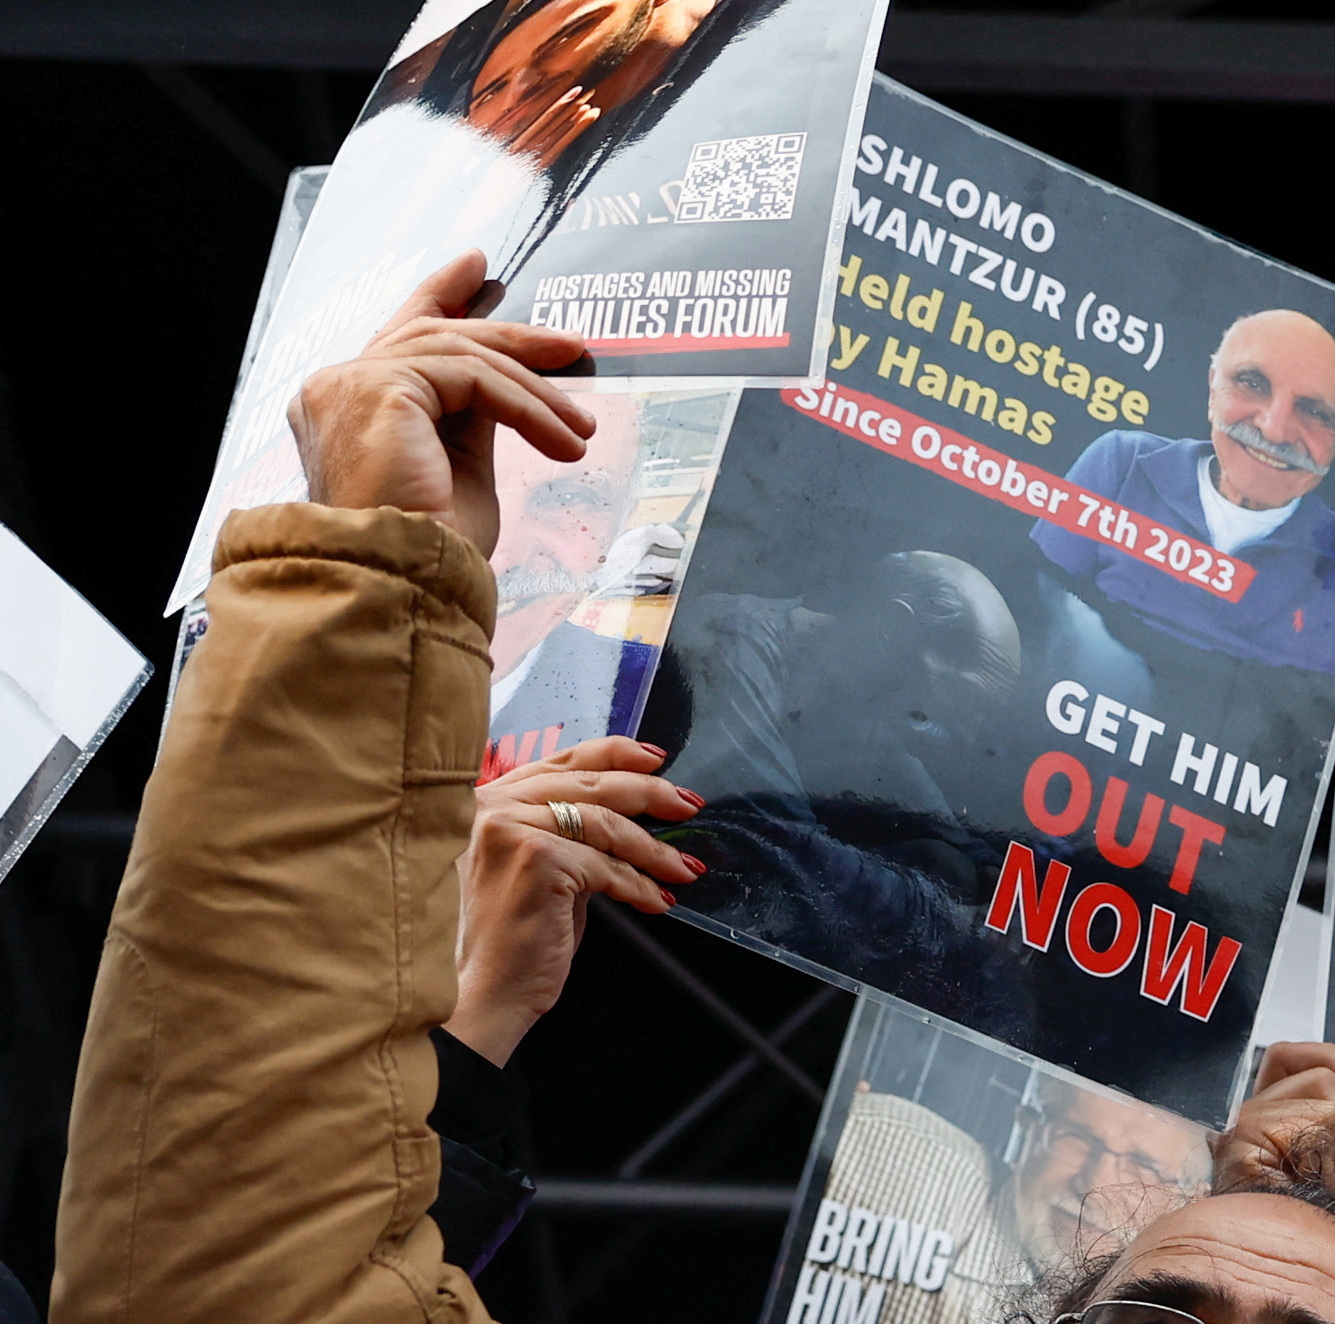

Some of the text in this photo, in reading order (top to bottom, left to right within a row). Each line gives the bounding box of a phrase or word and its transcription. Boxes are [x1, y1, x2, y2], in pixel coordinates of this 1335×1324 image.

[855, 133, 1056, 253] SHLOMO
[529, 297, 788, 340] FAMILIES FORUM
[534, 268, 792, 301] HOSTAGES AND MISSING
[836, 254, 1150, 425] Held hostage
[847, 185, 1165, 372] MANTZUR (85)
[829, 318, 1057, 446] y Hamas
[793, 380, 1237, 593] Since October 7th 2023
[1022, 750, 1227, 896] OUT
[1045, 679, 1288, 828] GET HIM
[983, 839, 1243, 1023] NOW
[805, 1199, 953, 1292] BRING
